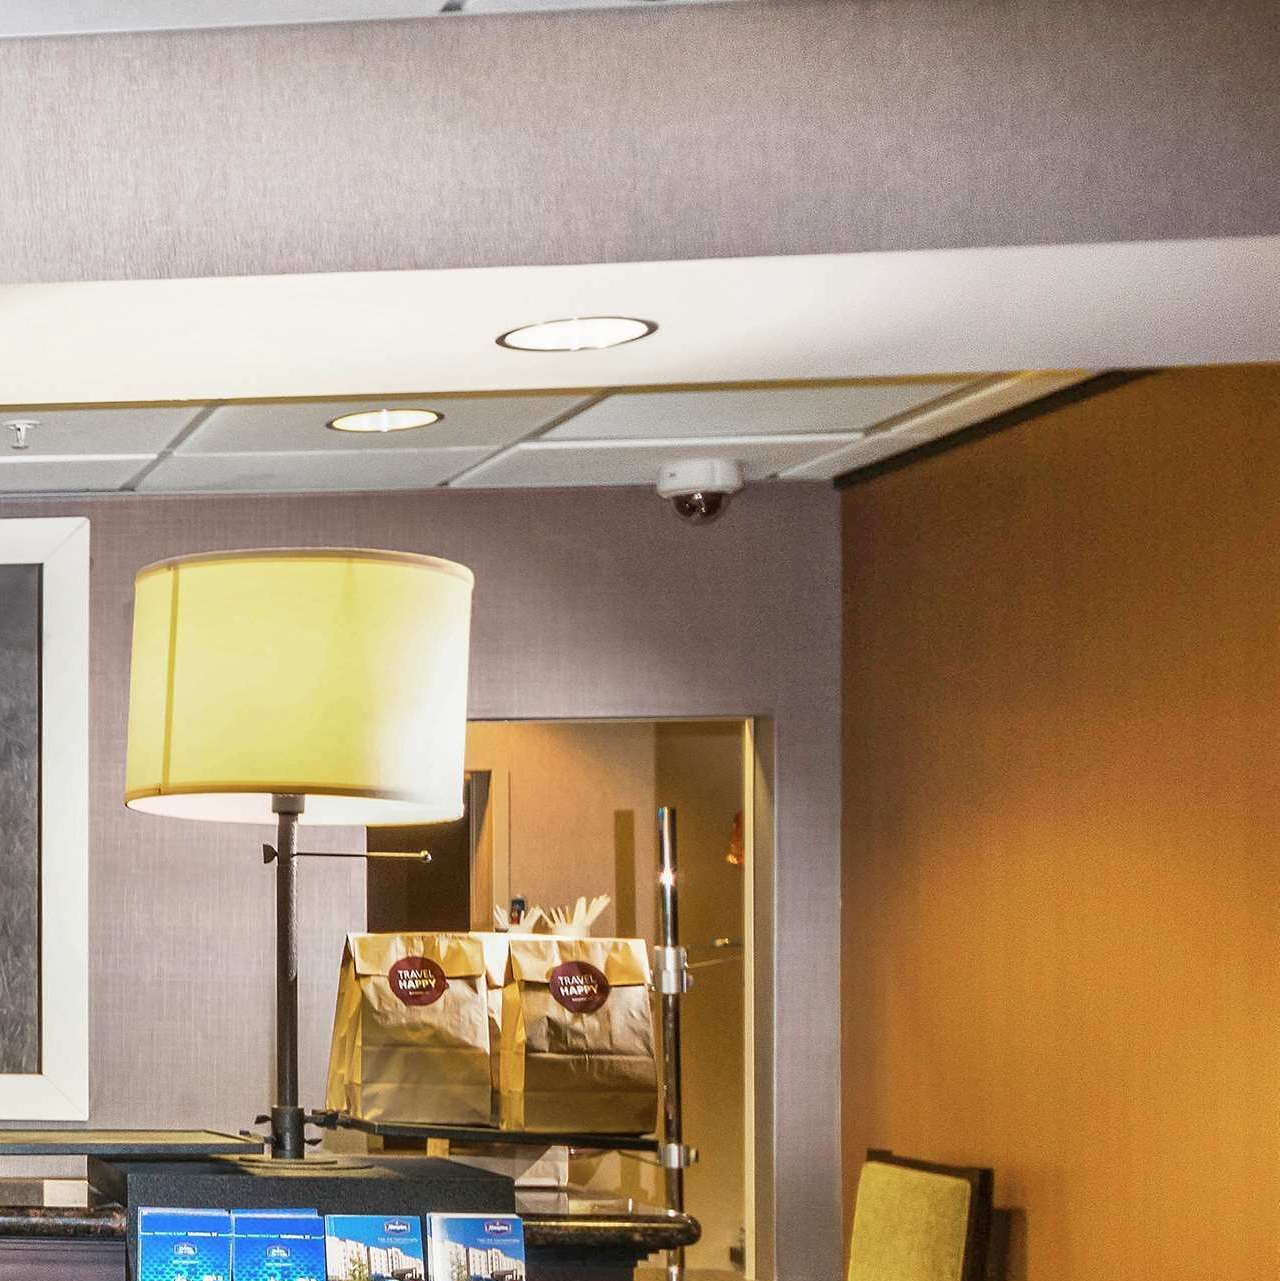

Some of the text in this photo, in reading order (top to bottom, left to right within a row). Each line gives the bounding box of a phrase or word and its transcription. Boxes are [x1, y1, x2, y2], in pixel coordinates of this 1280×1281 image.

[397, 969, 435, 980] TRAVEL
[398, 978, 437, 990] HAPPY
[557, 975, 596, 986] TRAVEL
[559, 984, 599, 997] HAPPY
